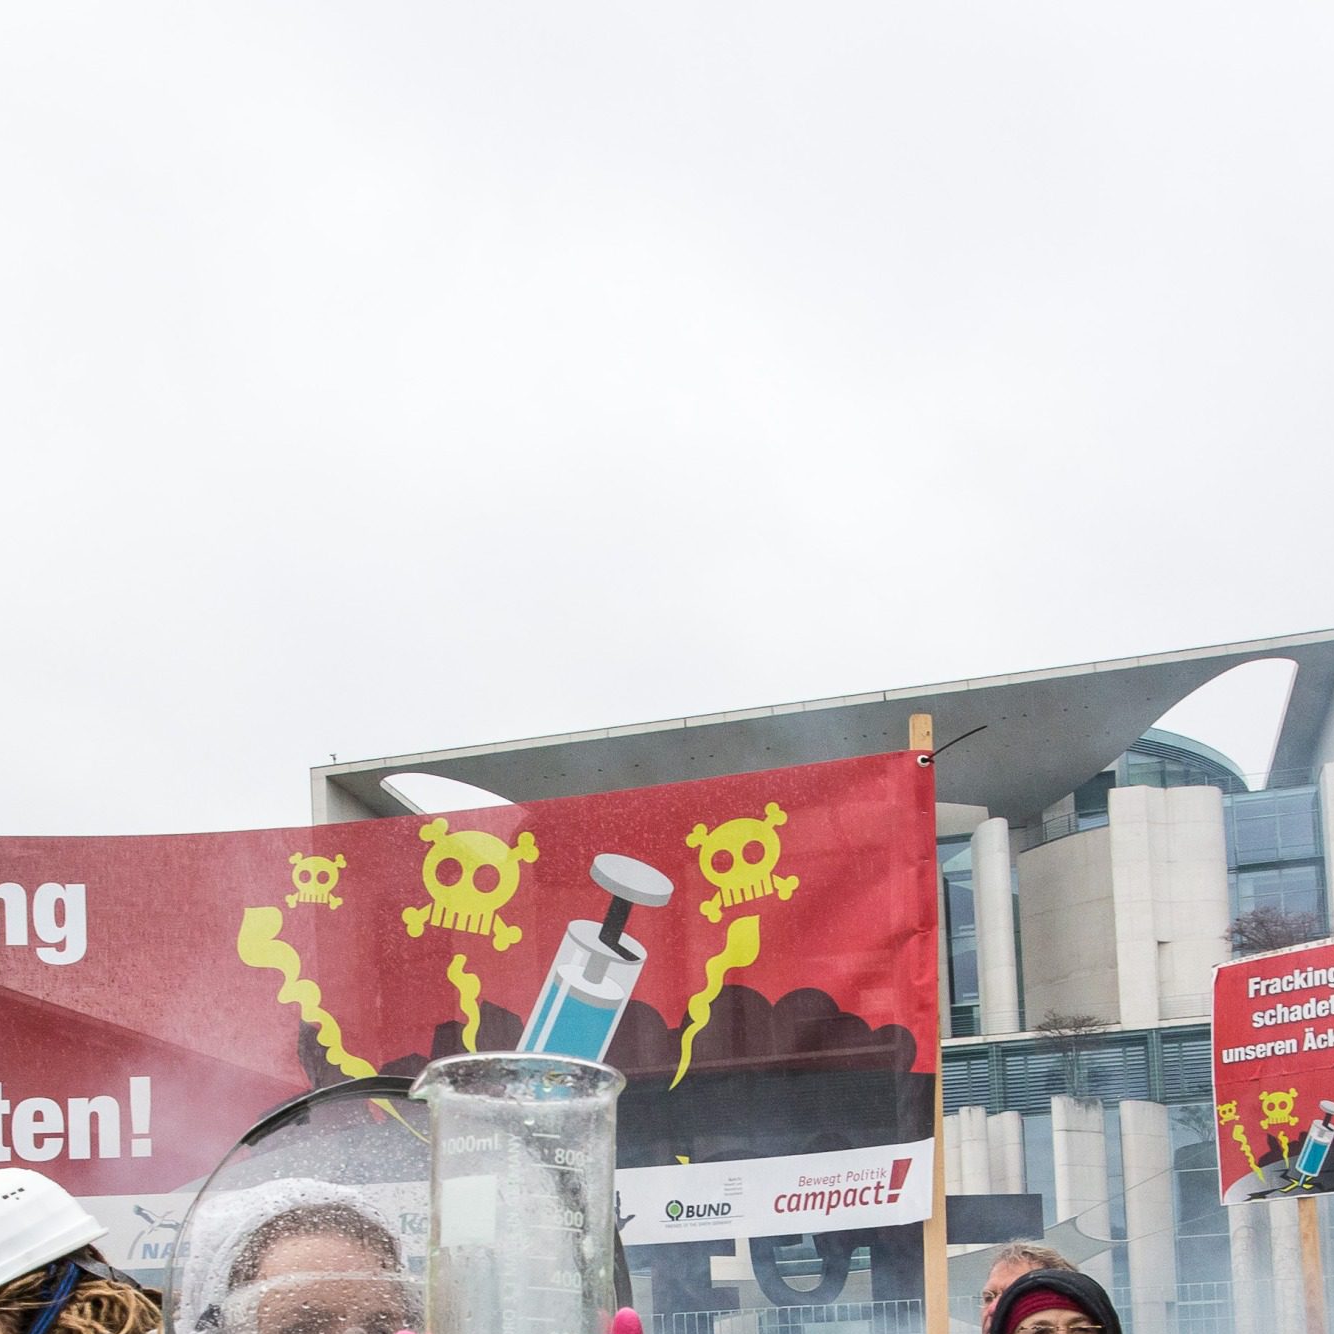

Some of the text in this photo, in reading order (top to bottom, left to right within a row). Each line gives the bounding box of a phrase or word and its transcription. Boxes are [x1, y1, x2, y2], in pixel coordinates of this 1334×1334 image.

[1222, 1038, 1298, 1064] unseren
[798, 1167, 887, 1187] Bewegt Politik
[686, 1203, 731, 1218] BUND
